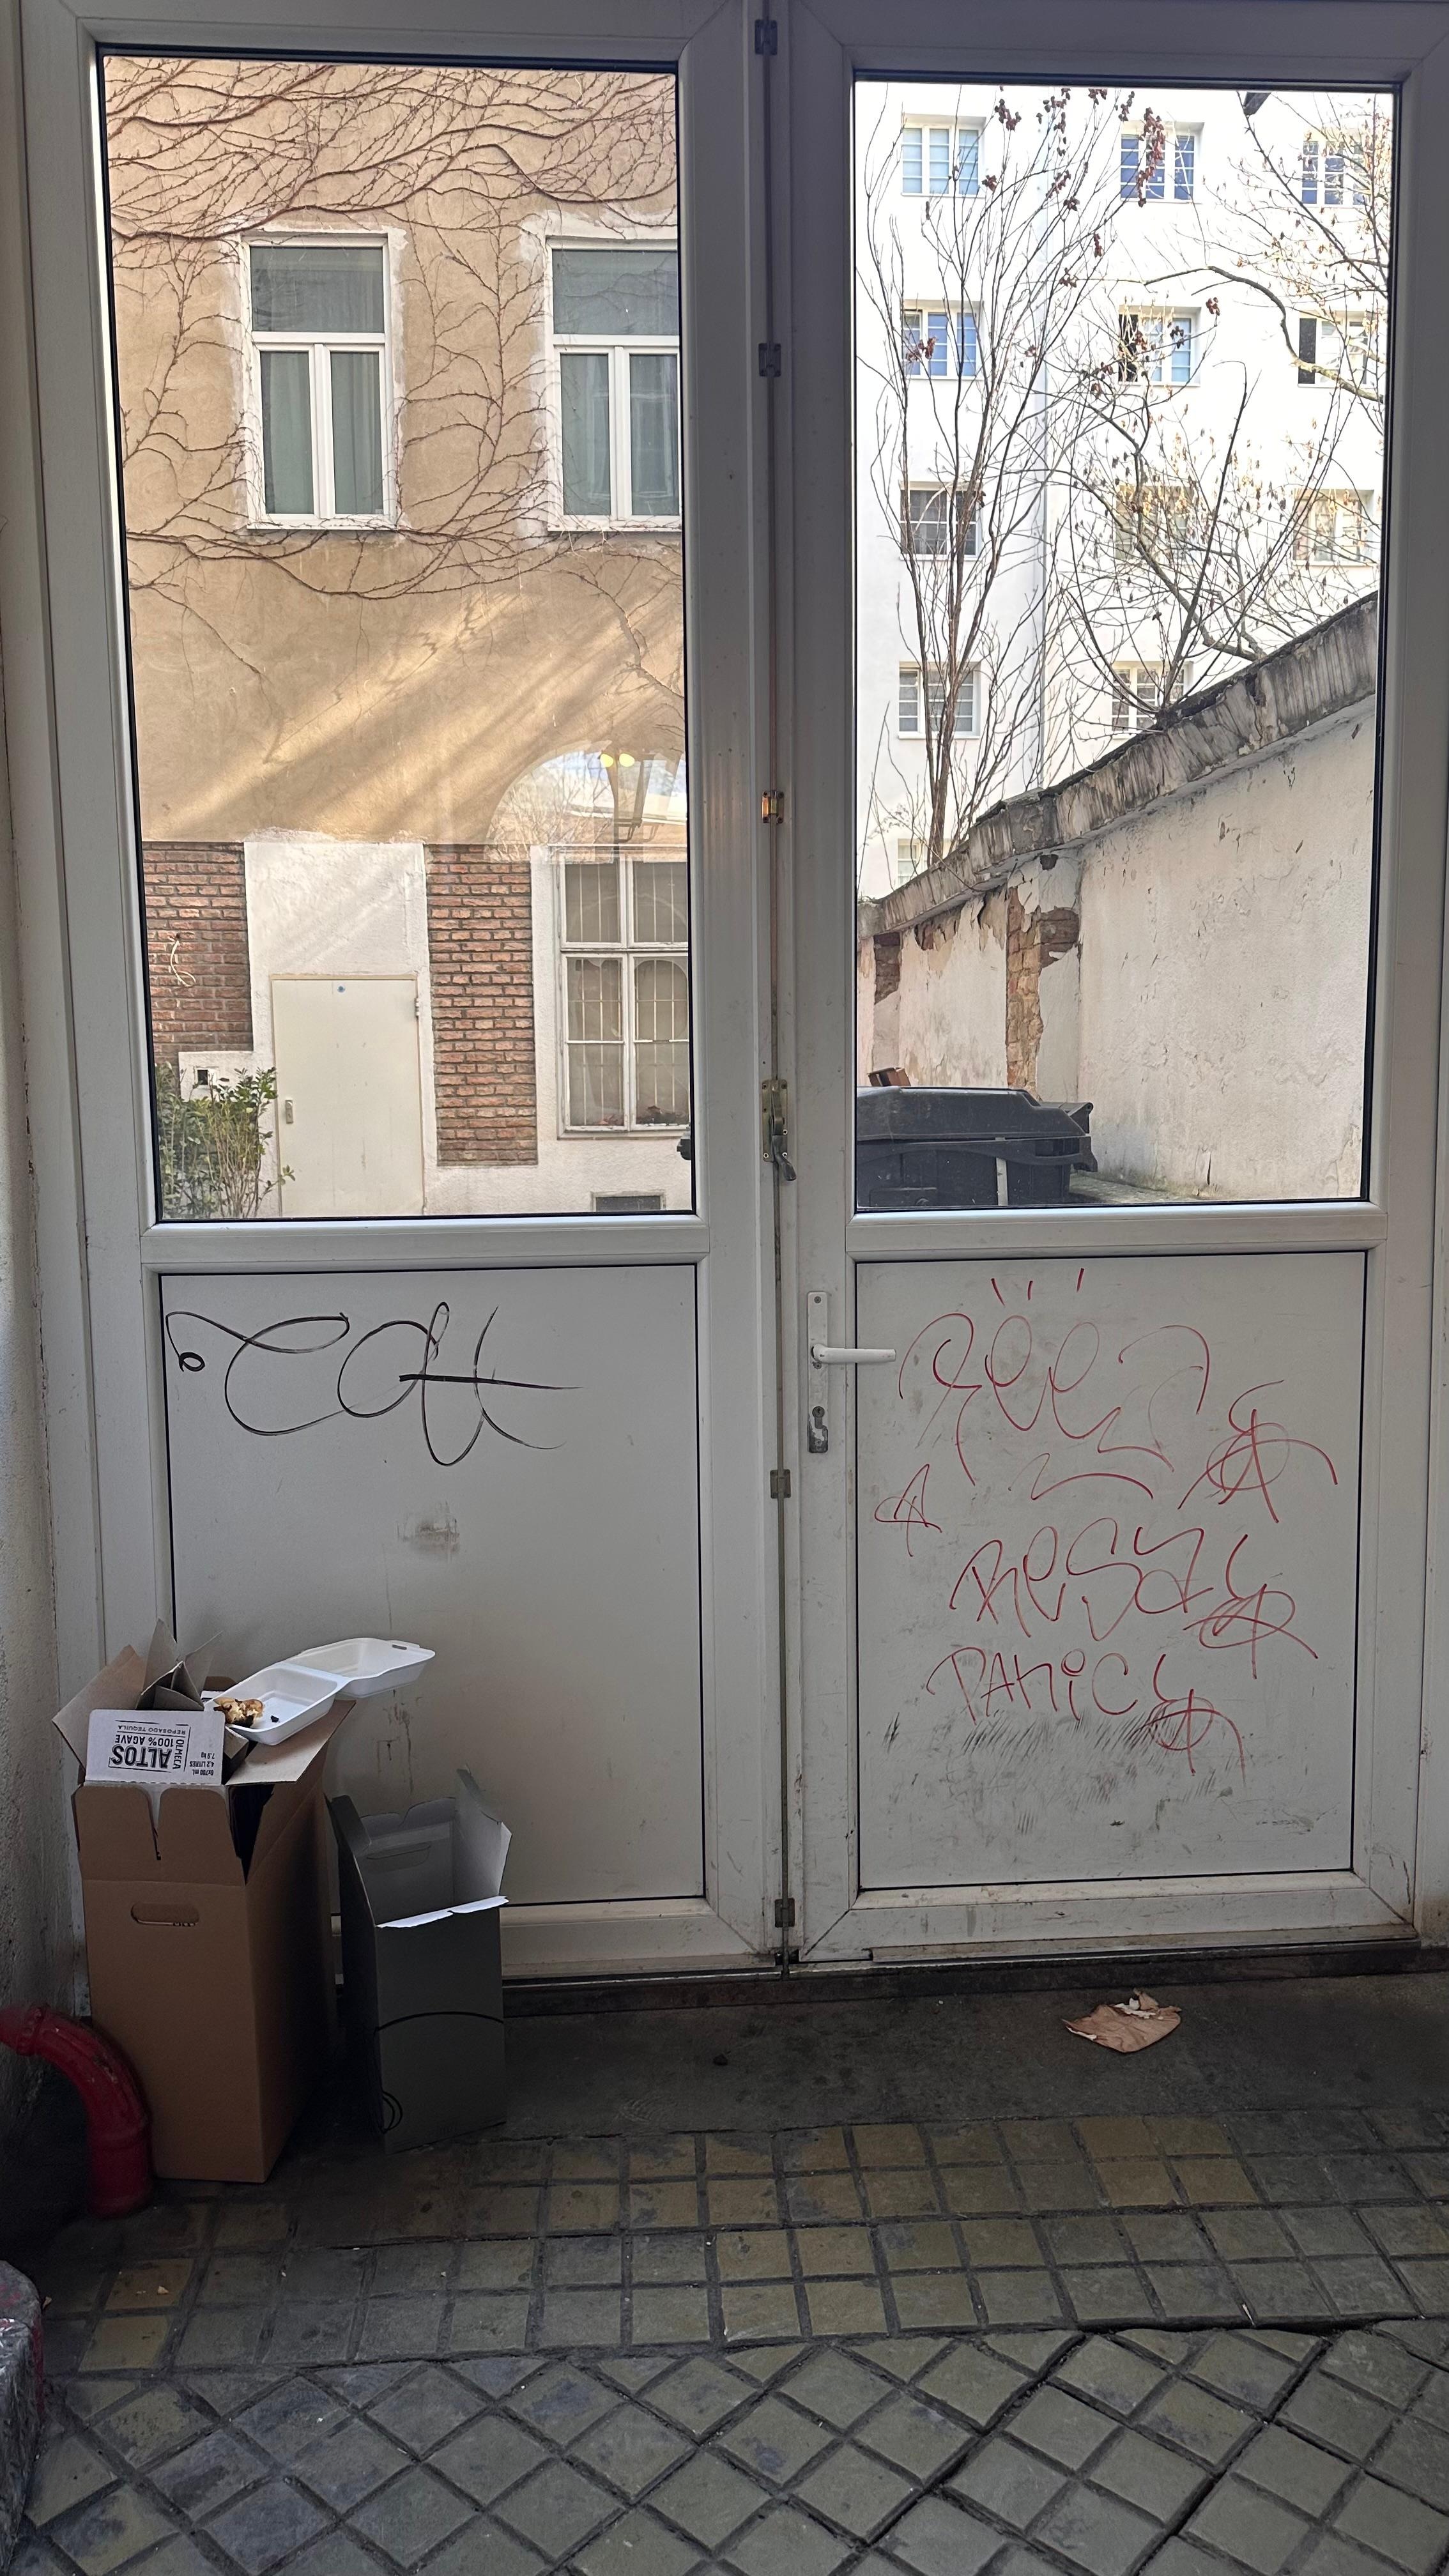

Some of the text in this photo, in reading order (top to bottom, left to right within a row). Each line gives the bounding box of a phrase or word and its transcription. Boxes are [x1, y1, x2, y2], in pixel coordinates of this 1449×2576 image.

[115, 1734, 174, 1747] 100% AGAVE
[111, 1744, 172, 1769] ALTOS
[172, 1739, 185, 1770] OLMECA
